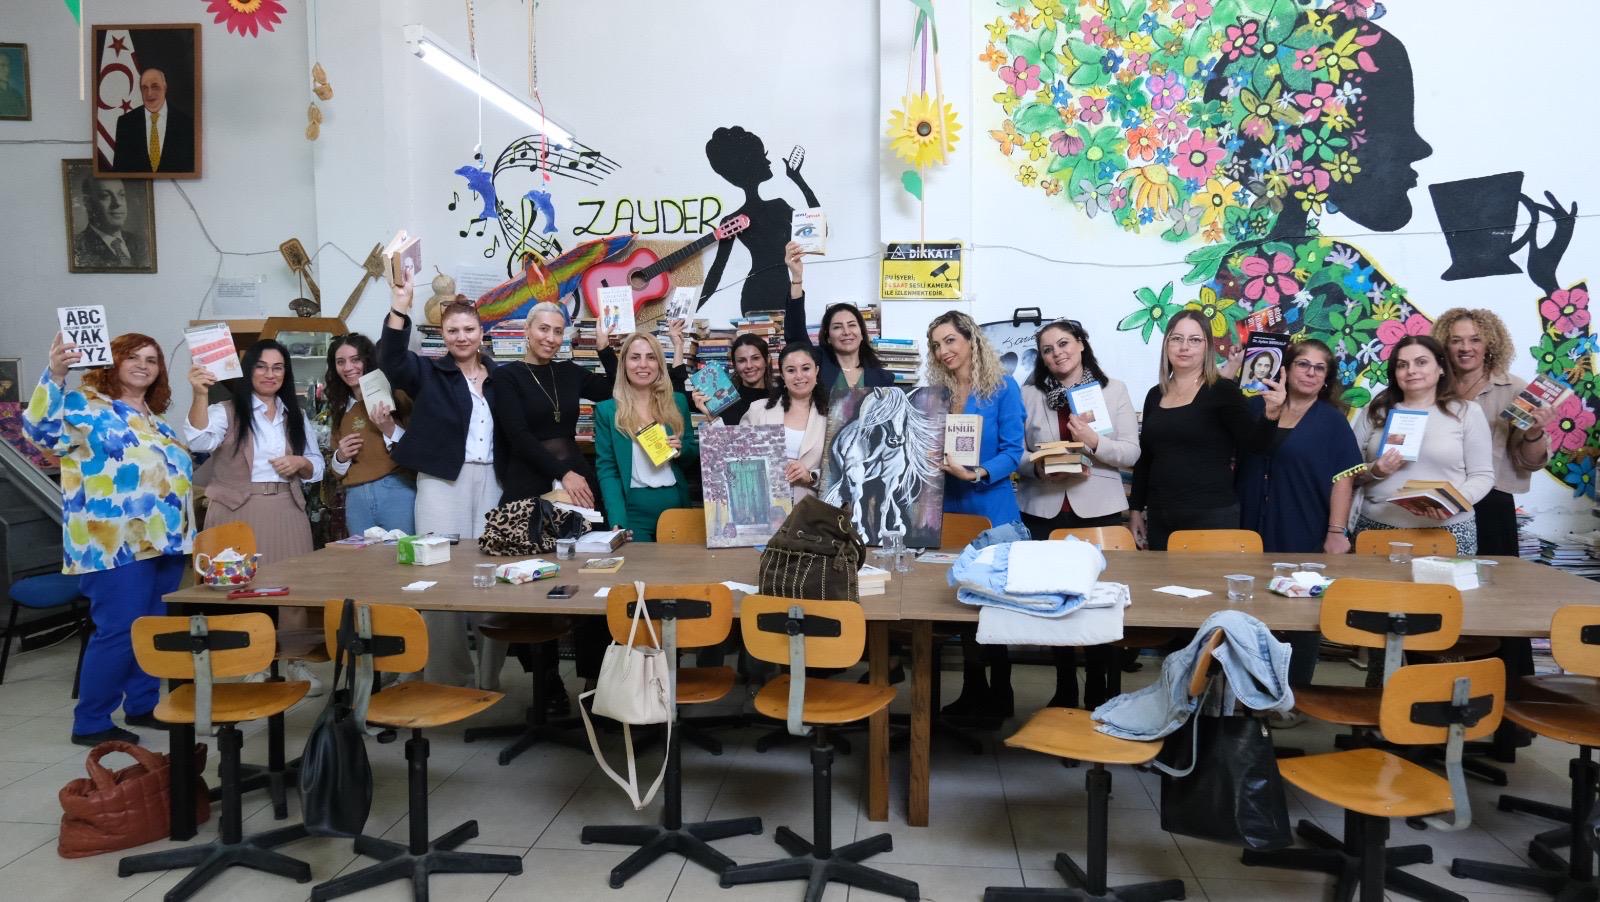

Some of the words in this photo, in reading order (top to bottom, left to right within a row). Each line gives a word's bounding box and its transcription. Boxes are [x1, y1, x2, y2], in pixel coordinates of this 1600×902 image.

[573, 196, 721, 236] ZAYDER
[909, 246, 953, 259] DİKKAT!
[66, 309, 101, 325] ABC
[67, 328, 103, 344] YAK
[70, 346, 107, 362] YZ
[947, 424, 975, 434] KİŞİLİK
